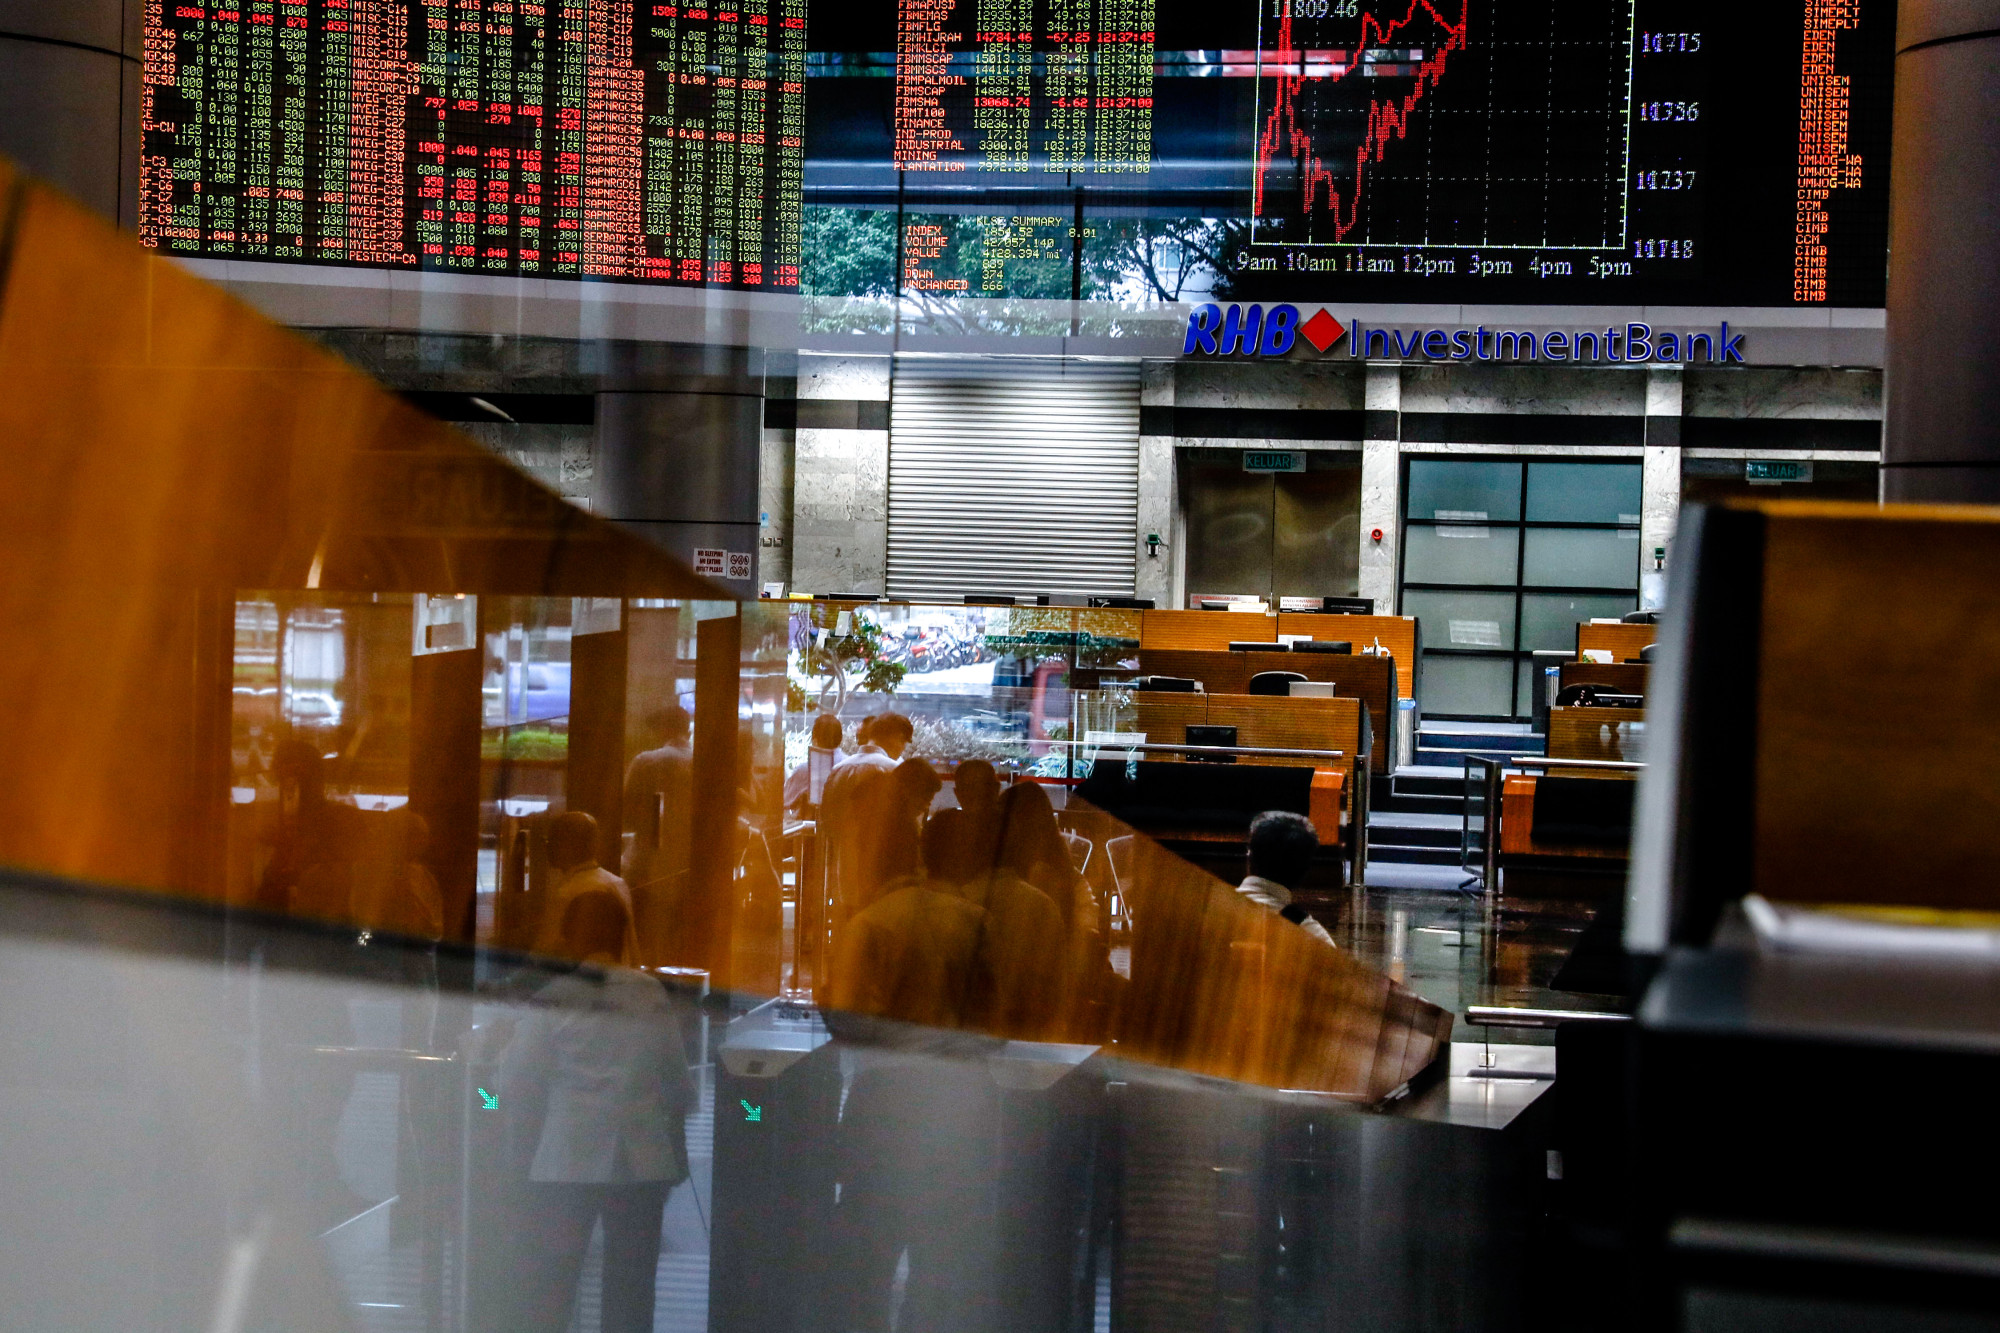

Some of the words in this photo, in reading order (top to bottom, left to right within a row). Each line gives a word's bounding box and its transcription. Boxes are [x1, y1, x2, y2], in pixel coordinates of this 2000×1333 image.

[354, 1, 408, 15] MISC-C14
[589, 0, 634, 13] POS-C15
[899, 0, 955, 9] FBMAPUSD
[899, 11, 948, 20] FBMEMAS
[977, 11, 1033, 20] 12935.34
[1055, 11, 1091, 20] 49.63
[1098, 10, 1155, 20] 12:37:00
[1804, 7, 1860, 18] SIMEPLT
[286, 17, 307, 29] 870
[321, 20, 348, 31] .055
[588, 22, 633, 35] POS-C17
[898, 22, 941, 31] FBMFLG
[977, 22, 1033, 31] 16953.96
[1047, 21, 1090, 31] 346.19
[1098, 21, 1155, 31] 12:37:00
[1804, 19, 1860, 29] SIMEPLT
[354, 24, 408, 37] MISC-C16
[1804, 30, 1835, 40] EDEN
[897, 33, 962, 42] FBMHIJRAH
[976, 32, 1033, 42] 14784.46
[1046, 32, 1090, 42] -67.25
[1097, 32, 1155, 42] 12:37:45
[588, 43, 633, 57] POS-C19
[897, 43, 946, 53] FBMKLCI
[983, 43, 1032, 53] 1854.52
[1061, 43, 1090, 53] 8.01
[1097, 43, 1154, 53] 12:37:45
[1803, 41, 1835, 52] EDEN
[286, 52, 307, 63] 500
[353, 47, 407, 60] MISC-C18
[896, 54, 953, 64] FBMMSCAP
[976, 54, 1032, 64] 15013.33
[1045, 54, 1089, 64] 339.45
[1097, 54, 1154, 64] 12:37:00
[1802, 52, 1834, 63] EDEN
[587, 66, 645, 80] SAPNRGC50
[896, 65, 947, 75] FBMMSCS
[975, 65, 1031, 75] 14414.48
[1046, 65, 1088, 75] 166.41
[1096, 65, 1154, 75] 12:37:00
[1802, 64, 1834, 75] EDEN
[896, 76, 967, 85] FBMPALMOIL
[975, 76, 1030, 85] 14535.81
[1045, 76, 1089, 86] 448.59
[1096, 76, 1153, 86] 12:37:45
[1802, 75, 1850, 86] UNISEM
[352, 80, 420, 95] MMCCORPC10
[896, 86, 945, 96] FBMSCAP
[975, 86, 1031, 96] 14882.75
[1045, 87, 1088, 96] 330.94
[1096, 87, 1153, 97] 12:37:00
[1801, 86, 1849, 98] UNISEM
[352, 92, 406, 105] MYEG-C25
[587, 88, 644, 102] SAPNRGC53
[895, 97, 939, 107] FBMSHA
[974, 97, 1031, 107] 13068.74
[1051, 97, 1088, 108] -6.62
[1095, 97, 1153, 108] 12:37:00
[1801, 98, 1849, 109] UNISEM
[586, 110, 644, 124] SAPNRGC55
[895, 108, 945, 117] FBMT100
[974, 108, 1030, 118] 12731.70
[1051, 108, 1087, 118] 33.26
[1095, 108, 1152, 119] 12:37:45
[1800, 109, 1848, 121] UNISEM
[352, 114, 405, 128] MYEG-C27
[895, 119, 945, 129] FINANCE
[974, 119, 1030, 129] 18236.10
[1044, 119, 1086, 129] 145.51
[1095, 120, 1152, 130] 12:37:00
[1800, 120, 1848, 132] UNISEM
[895, 129, 952, 139] IND-PROD
[987, 130, 1028, 140] 177.31
[1057, 131, 1087, 140] 6.29
[1094, 131, 1151, 141] 12:37:00
[1799, 132, 1847, 143] UNISEM
[351, 137, 405, 151] MYEG-C29
[895, 140, 965, 150] INDUSTRIAL
[979, 140, 1029, 150] 3300.04
[1043, 141, 1087, 151] 103.49
[1094, 142, 1151, 151] 12:37:00
[1799, 143, 1847, 155] UNISEM
[516, 150, 542, 161] 1165
[585, 143, 643, 157] SAPNRGC58
[894, 151, 937, 161] MINING
[986, 151, 1029, 161] 928.10
[1050, 152, 1086, 162] 28.37
[1093, 152, 1150, 162] 12:37:00
[1799, 154, 1862, 166] UMWOG-WA
[350, 160, 403, 173] MYEG-C31
[585, 165, 642, 179] SAPNRGC60
[893, 162, 965, 171] PLANTATION
[978, 162, 1029, 172] 7972.58
[1043, 163, 1086, 173] 122.86
[1093, 163, 1150, 173] 12:37:00
[1798, 166, 1862, 177] UMWOG-WA
[1798, 178, 1861, 188] UMWOG-WA
[276, 189, 304, 200] 7400
[350, 182, 404, 196] MYEG-C33
[417, 187, 444, 198] 1585
[584, 188, 641, 201] SAPNRGC62
[1797, 189, 1829, 199] CIMB
[318, 192, 344, 203] .005
[514, 194, 540, 205] 2110
[1797, 200, 1821, 210] CCM
[350, 205, 404, 218] MYEG-C35
[422, 210, 443, 221] 519
[584, 210, 640, 223] SAPNRGC64
[1796, 212, 1829, 222] CIMB
[1012, 217, 1062, 226] SUMMARY
[906, 225, 942, 235] INDEX
[984, 227, 1033, 237] 1854.52
[1068, 228, 1096, 238] 8.01
[1796, 223, 1828, 233] CIMB
[349, 228, 403, 241] MYEG-C37
[583, 231, 646, 245] SERBADK-CF
[1796, 234, 1820, 244] CCM
[905, 236, 948, 247] VOLUME
[583, 242, 647, 256] SERBADK-CG
[905, 247, 941, 258] VALUE
[982, 249, 1040, 259] 4128.394
[1795, 245, 1827, 256] CIMB
[349, 250, 416, 264] PESTECH-CA
[1795, 256, 1827, 267] CIMB
[904, 258, 920, 268] UP
[1238, 251, 1278, 270] 9am
[1287, 251, 1337, 271] 10am
[1344, 253, 1396, 272] 11am
[1402, 253, 1456, 277] 12pm
[1468, 254, 1513, 277] 3pm
[1529, 255, 1572, 278] 4pm
[1588, 255, 1633, 279] 5pm
[742, 273, 762, 284] 300
[904, 269, 934, 279] DOWN
[982, 269, 1004, 280] 374
[1794, 268, 1827, 278] CIMB
[773, 275, 798, 286] .135
[903, 279, 969, 290] UNCHANGED
[981, 281, 1004, 291] 666
[1794, 279, 1826, 290] CIMB
[1793, 290, 1826, 301] CIMB
[1182, 302, 1299, 356] RHB
[1349, 319, 1747, 363] InvestmentBank
[1246, 455, 1290, 468] KELUAR
[1750, 464, 1796, 477] KELUAR
